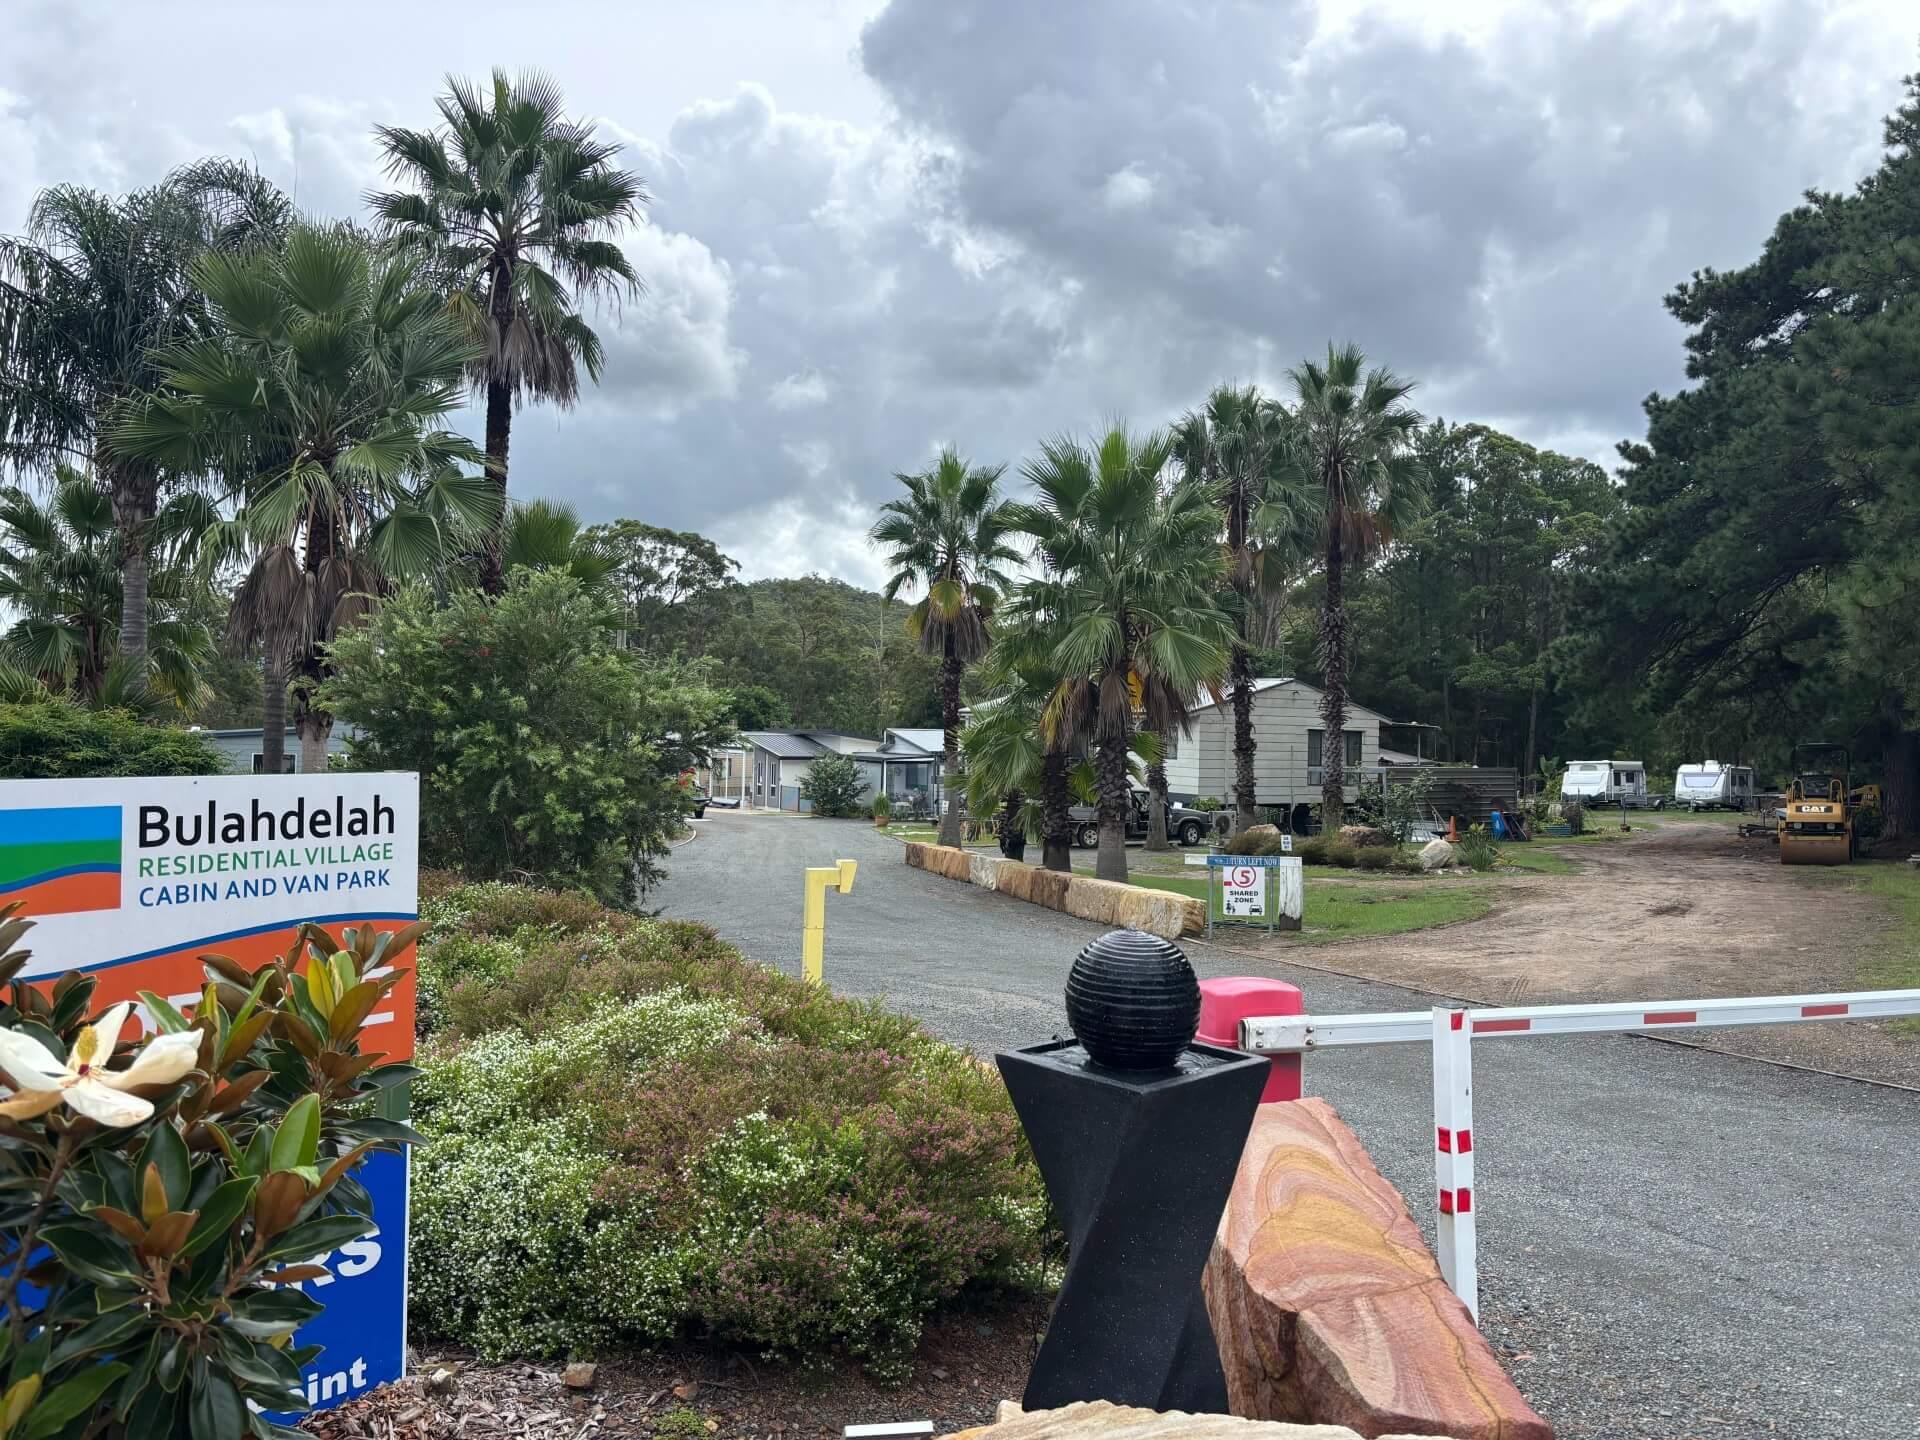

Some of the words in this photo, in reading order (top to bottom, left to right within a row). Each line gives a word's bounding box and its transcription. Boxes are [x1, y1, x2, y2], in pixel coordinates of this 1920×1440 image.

[139, 795, 395, 848] Bulahdelah
[139, 847, 300, 878] RESIDENTIAL
[304, 842, 393, 866] VILLAGE
[1240, 870, 1250, 884] 5
[1248, 857, 1264, 866] LEFT
[1264, 857, 1277, 866] NOW
[139, 880, 218, 907] CABIN
[225, 877, 277, 900] AND
[283, 874, 330, 895] VAN
[336, 868, 391, 891] PARK
